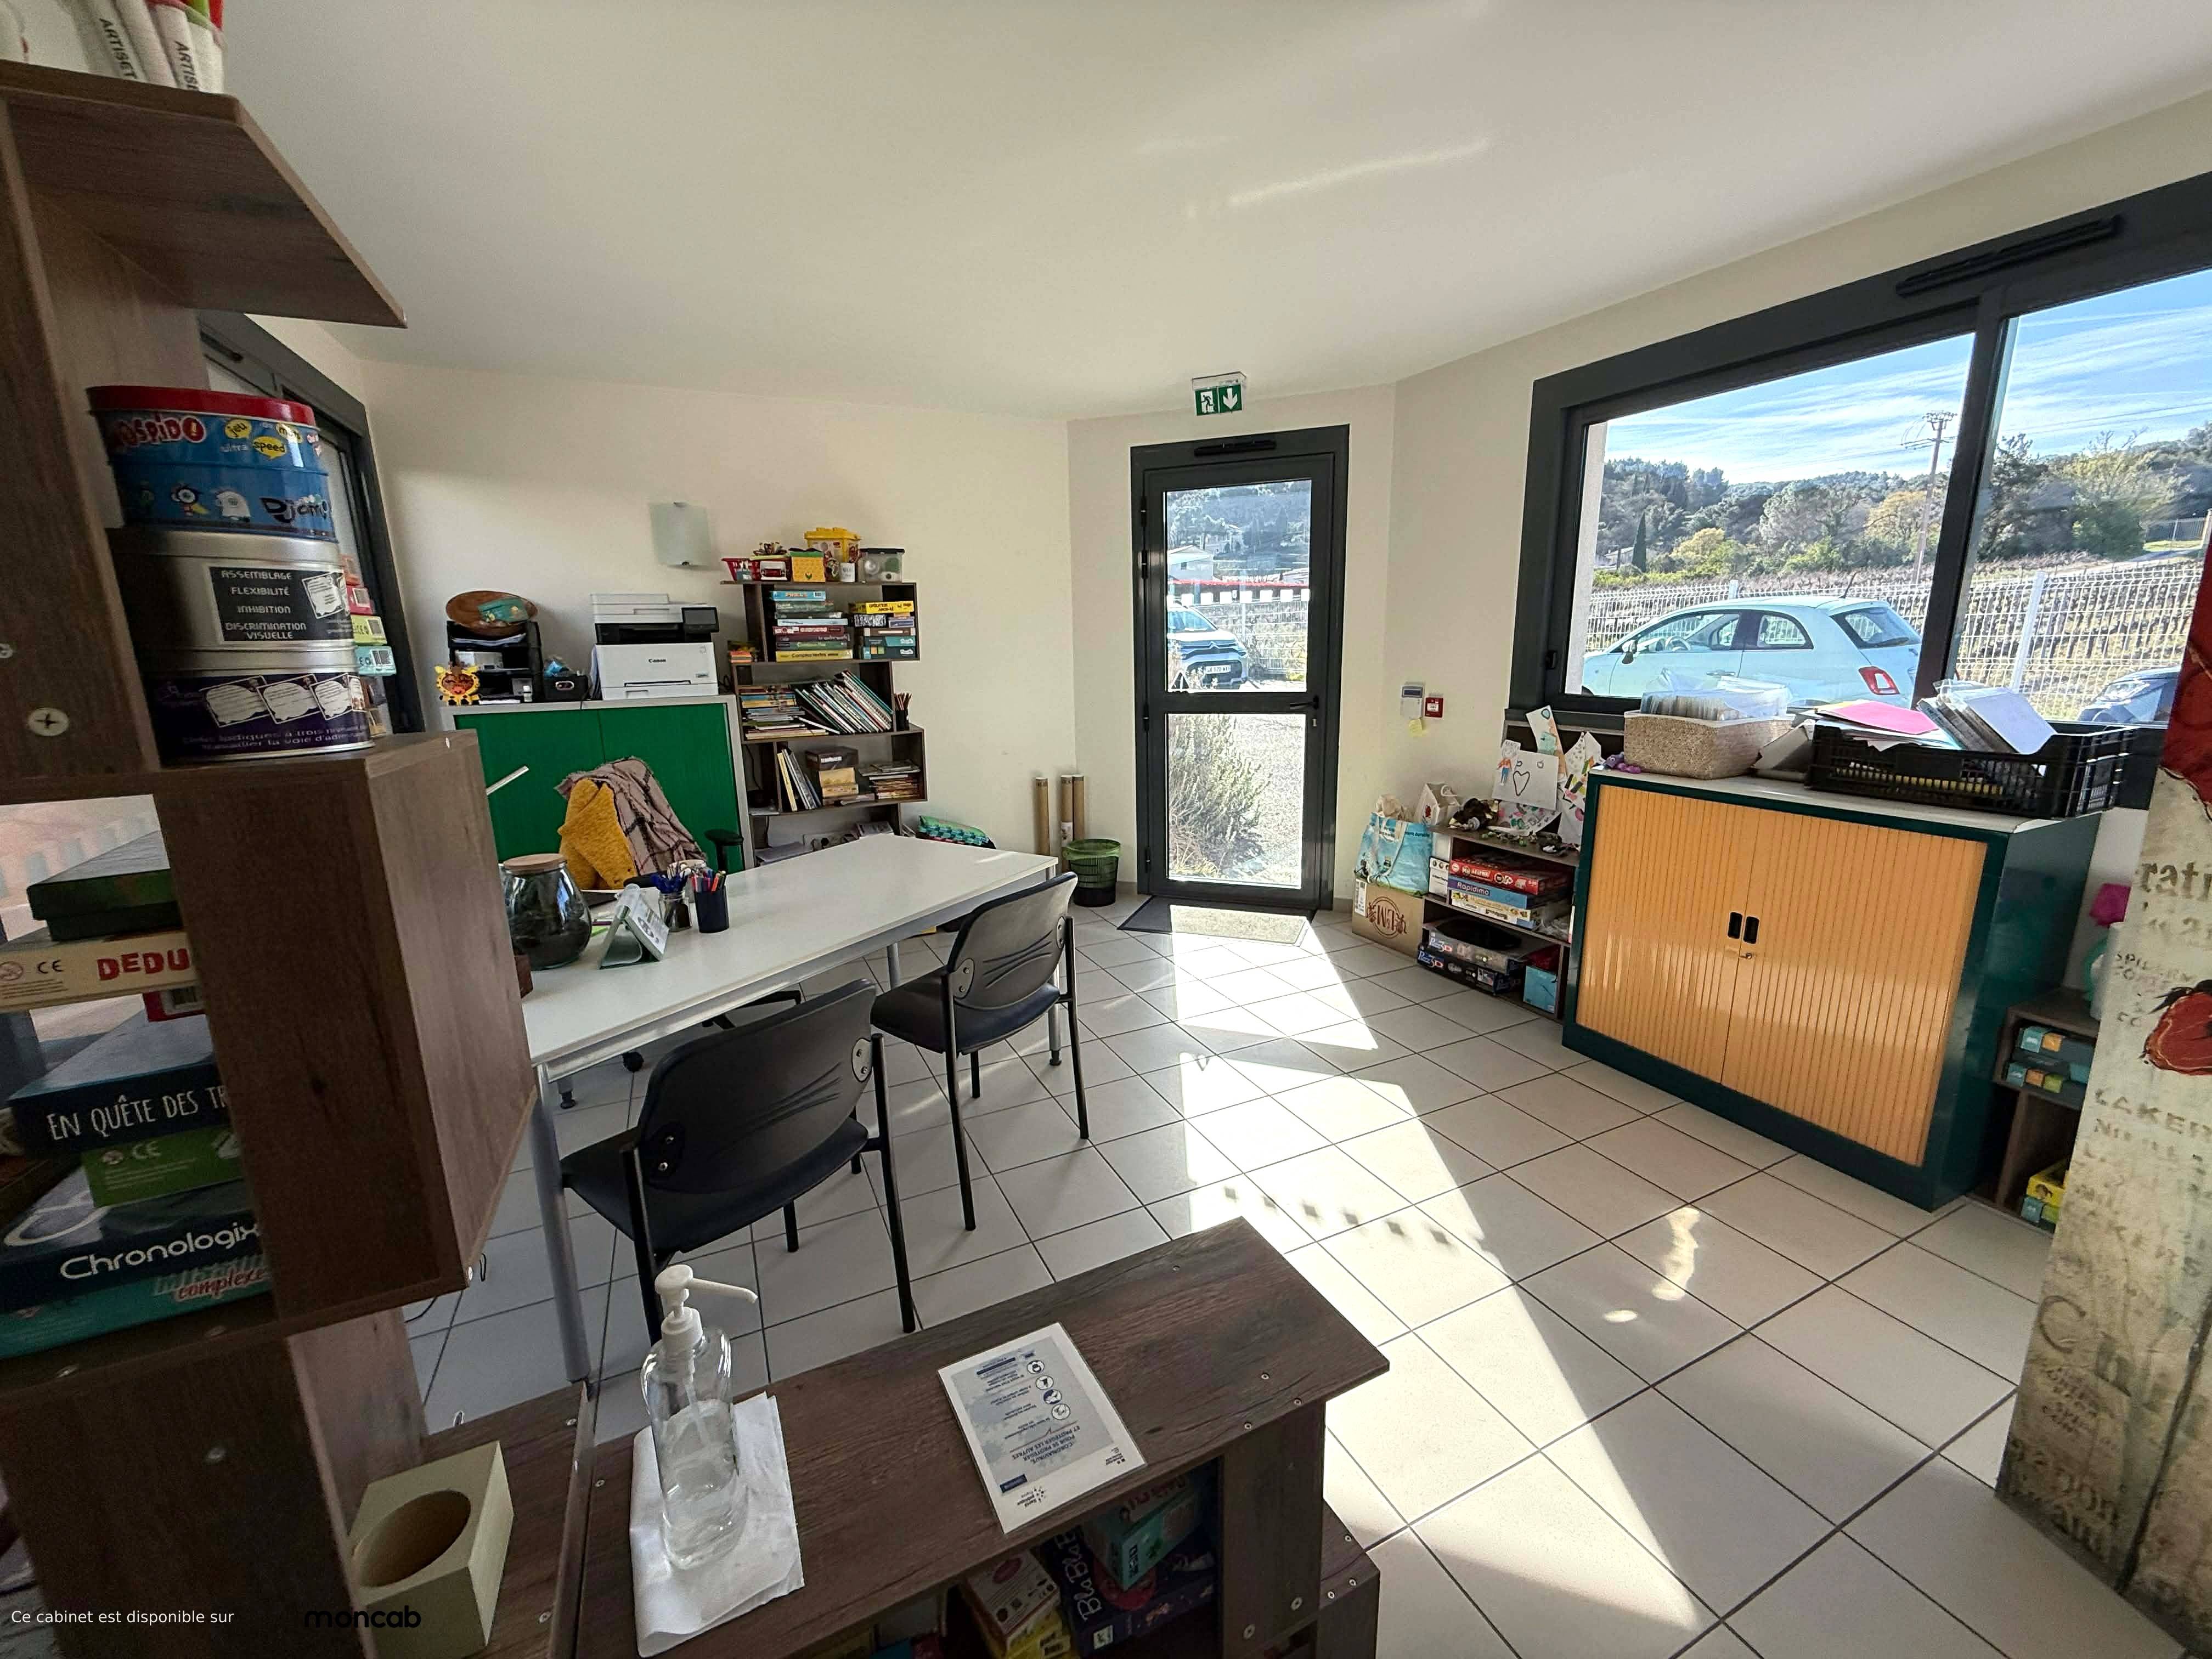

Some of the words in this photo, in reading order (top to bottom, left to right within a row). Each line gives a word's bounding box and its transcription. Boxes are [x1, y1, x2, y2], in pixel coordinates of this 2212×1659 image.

[99, 18, 137, 80] ARTISET
[253, 441, 286, 453] speed
[221, 570, 292, 580] ASSEMBLAGE
[230, 586, 290, 596] FLEXIBILITÉ
[237, 605, 291, 614] INHIBITION
[225, 622, 307, 631] DISCRIMINATION
[246, 631, 294, 640] VISUELLE
[1457, 881, 1489, 896] Rapidimo
[37, 959, 65, 974] CE
[46, 1112, 81, 1141] EN
[91, 1094, 157, 1138] QUÊTE
[162, 1090, 199, 1119] DES
[59, 1221, 261, 1280] Chronologix
